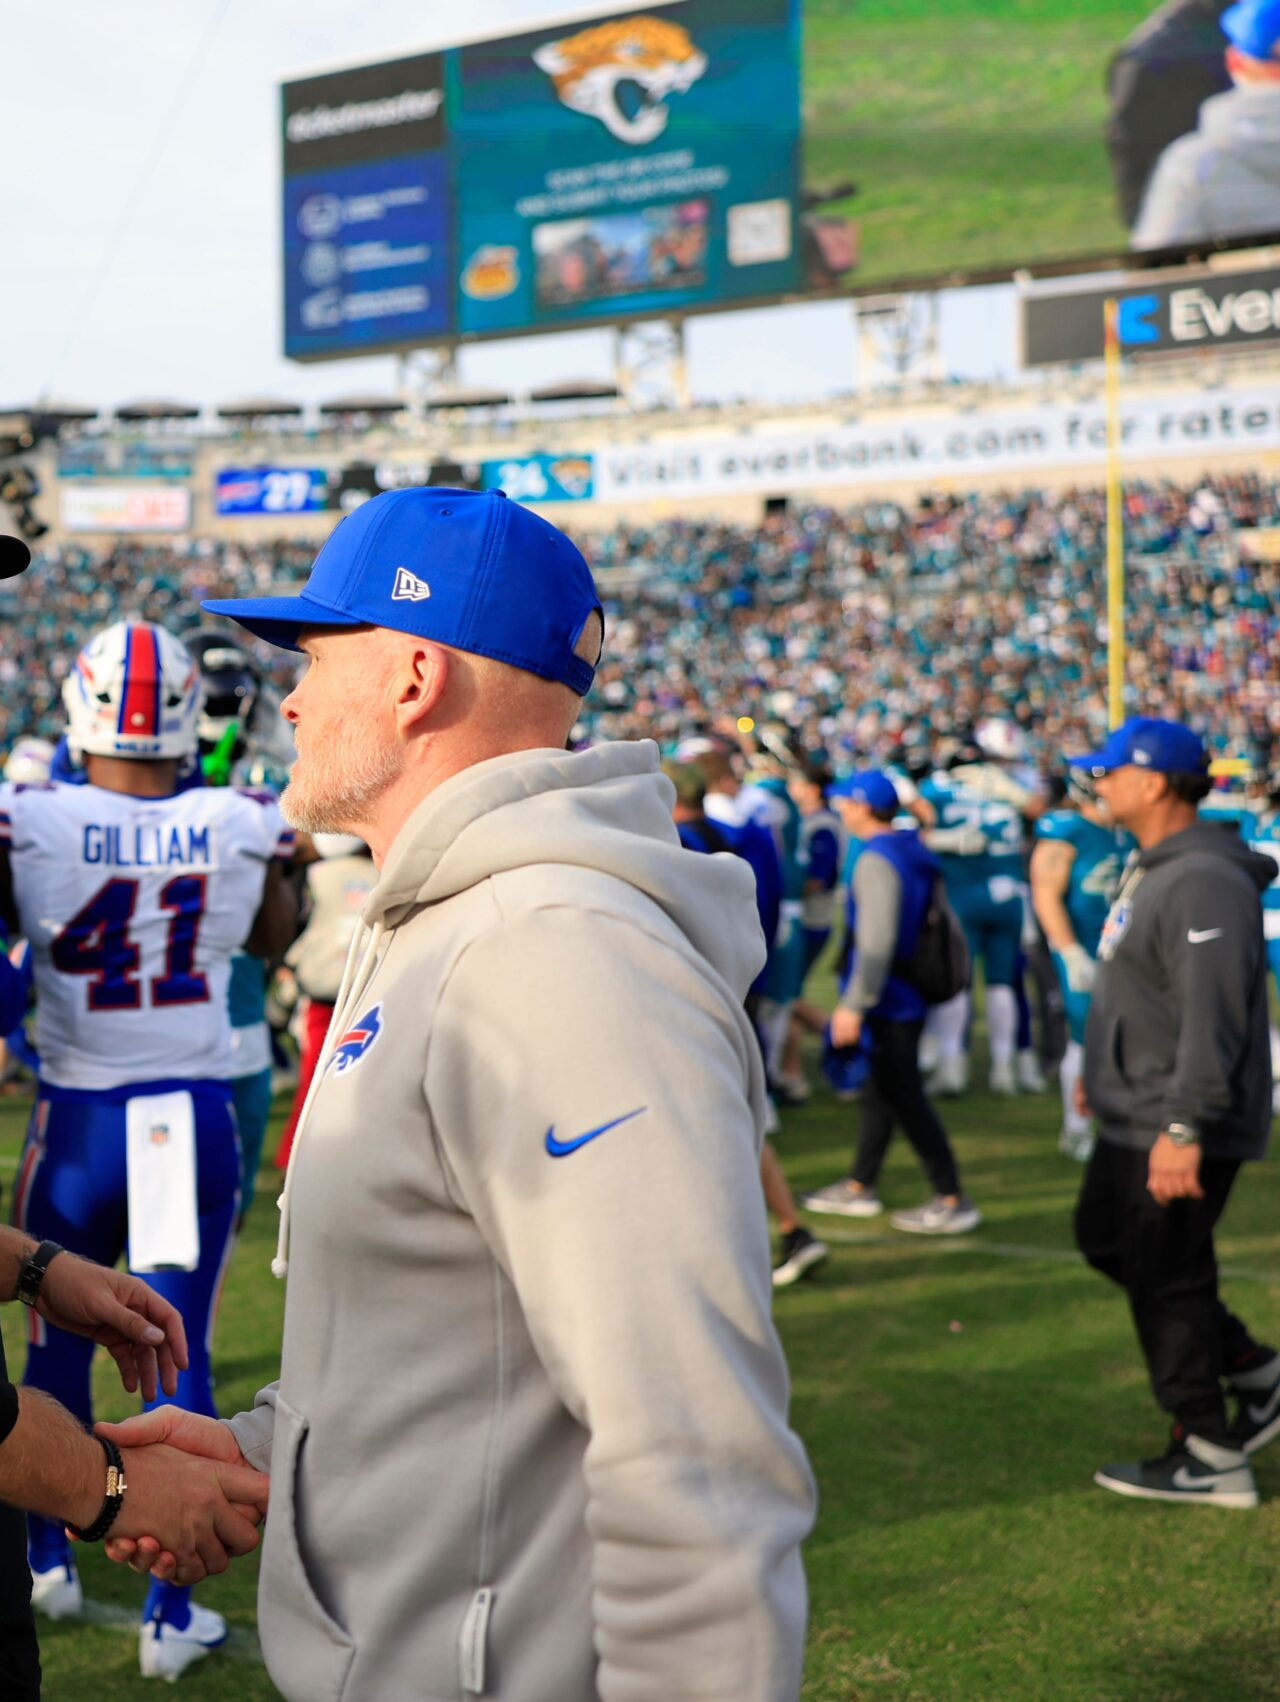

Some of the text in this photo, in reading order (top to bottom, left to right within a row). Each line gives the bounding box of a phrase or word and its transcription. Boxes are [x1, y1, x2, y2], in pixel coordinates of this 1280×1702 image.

[606, 403, 1280, 485] Visit everbank.com for rate
[83, 824, 211, 866] GILLIAM
[51, 874, 211, 1011] 41
